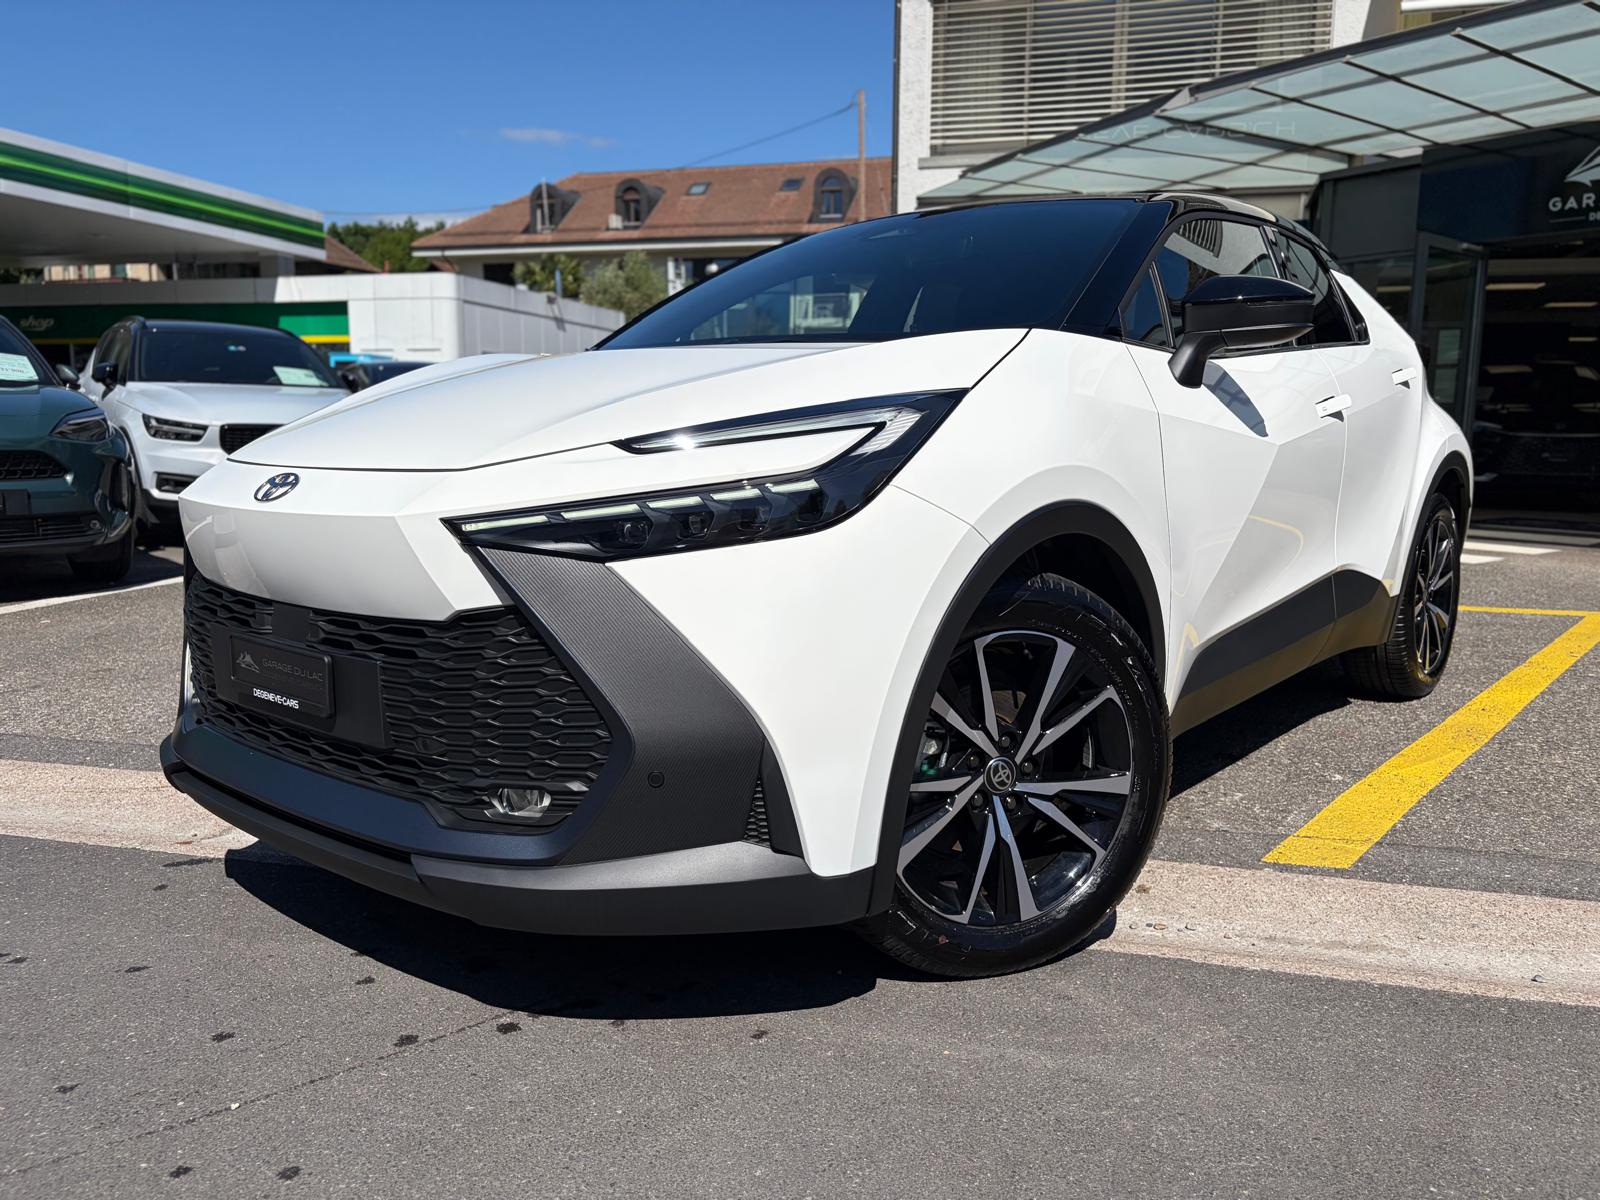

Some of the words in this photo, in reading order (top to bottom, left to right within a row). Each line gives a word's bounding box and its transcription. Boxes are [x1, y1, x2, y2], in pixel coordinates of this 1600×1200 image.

[1549, 193, 1597, 212] GAR
[20, 315, 54, 331] shop
[262, 658, 293, 674] GARAGE
[307, 669, 324, 682] LAC
[253, 687, 299, 709] DEGENEVE-CARS
